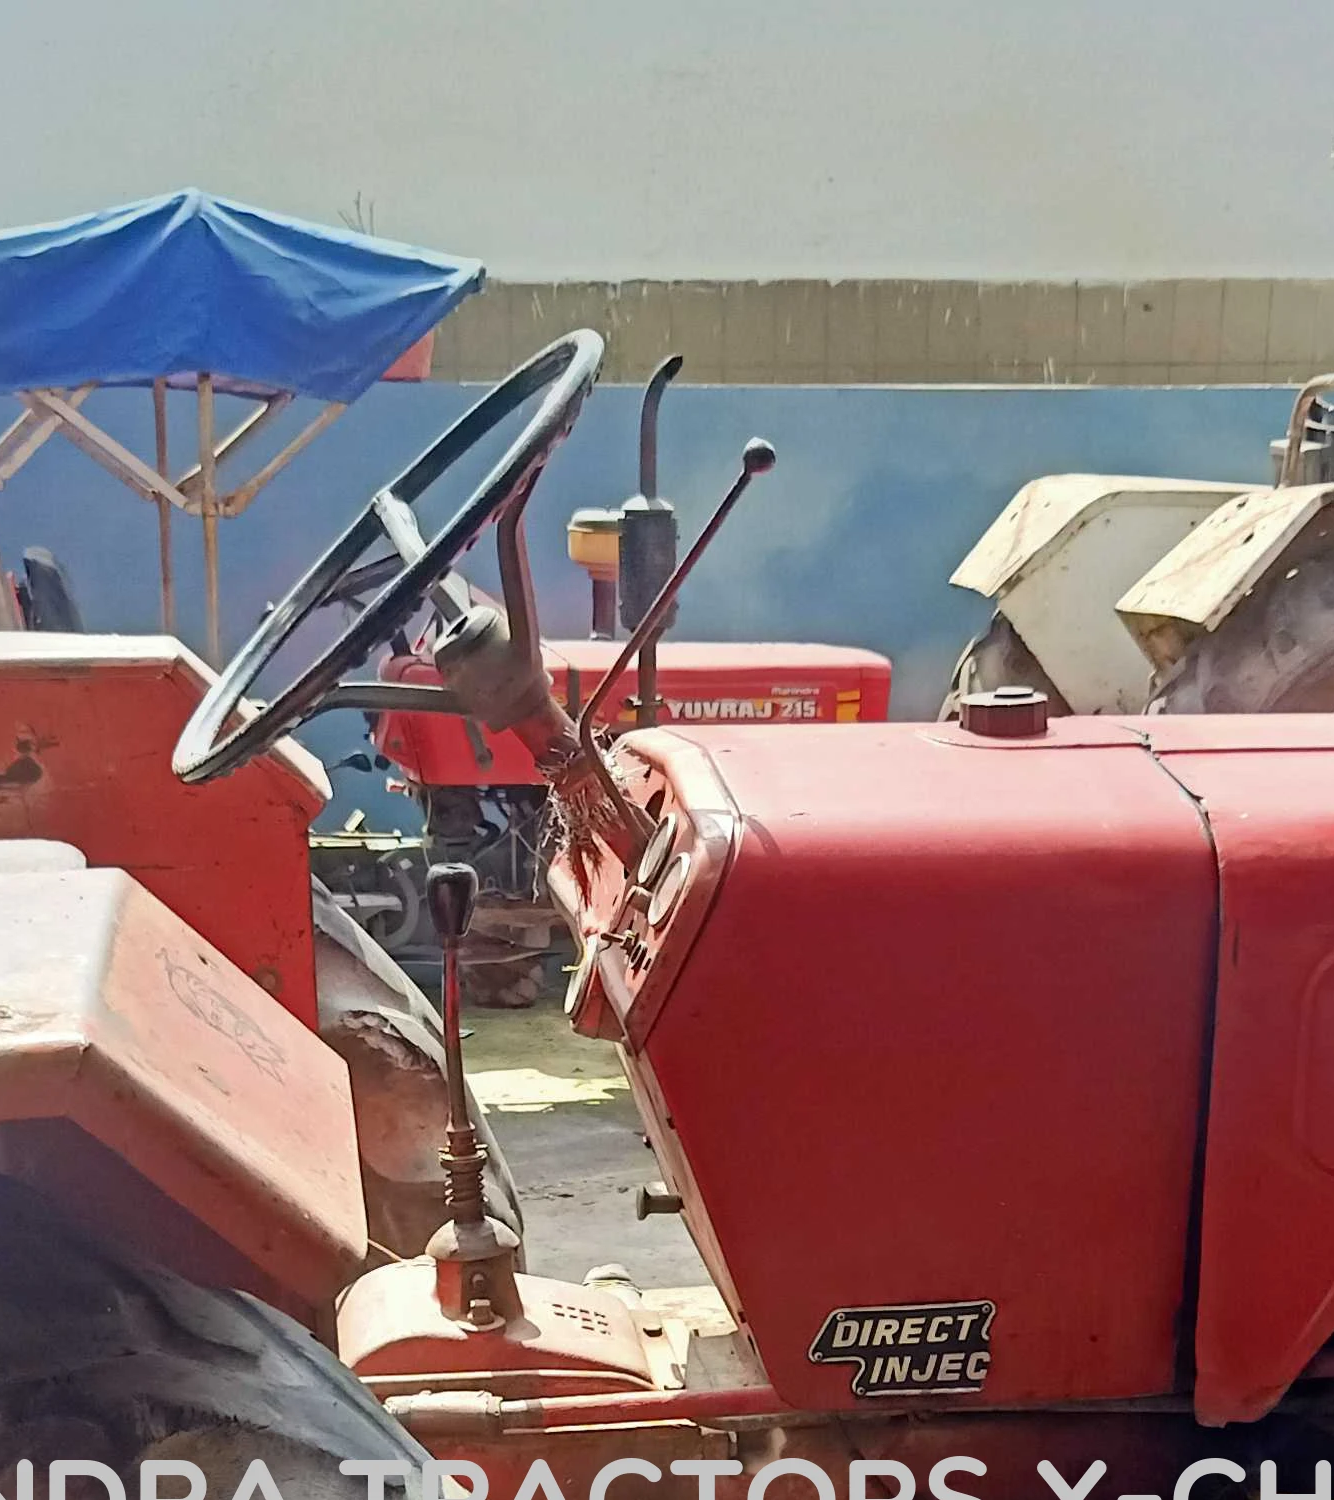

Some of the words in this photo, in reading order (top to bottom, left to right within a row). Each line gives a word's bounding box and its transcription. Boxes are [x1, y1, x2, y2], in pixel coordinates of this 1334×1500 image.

[667, 699, 772, 719] YUVRAJ
[779, 700, 817, 719] 215
[832, 1314, 979, 1348] DIRECT
[870, 1351, 991, 1384] INJEC
